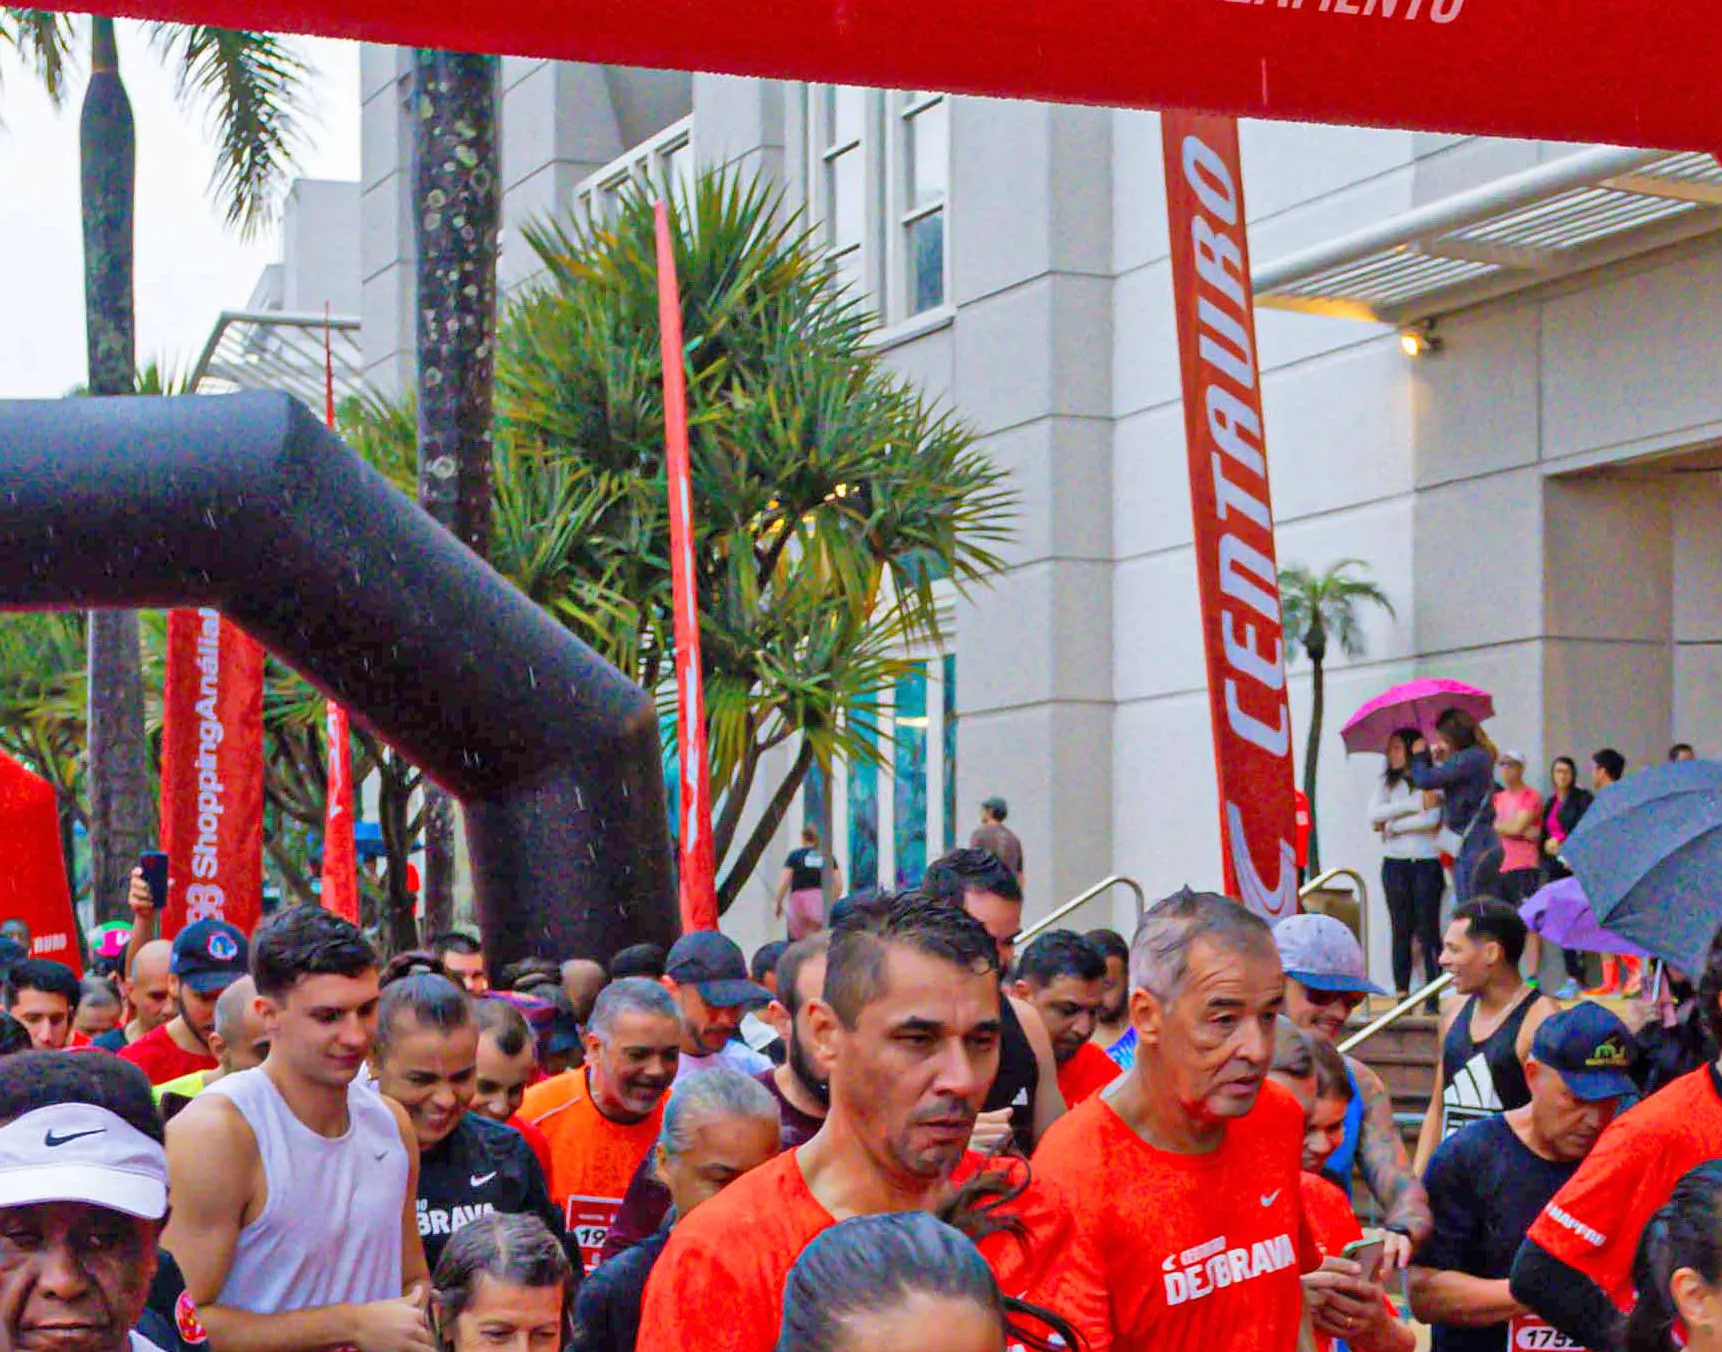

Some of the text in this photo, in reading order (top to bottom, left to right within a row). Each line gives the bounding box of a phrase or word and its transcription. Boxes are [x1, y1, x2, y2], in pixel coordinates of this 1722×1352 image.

[1182, 134, 1291, 758] CENTAURO
[416, 1202, 496, 1237] BRAVA
[580, 1228, 608, 1244] 19
[1163, 1233, 1296, 1306] DESBRAVA
